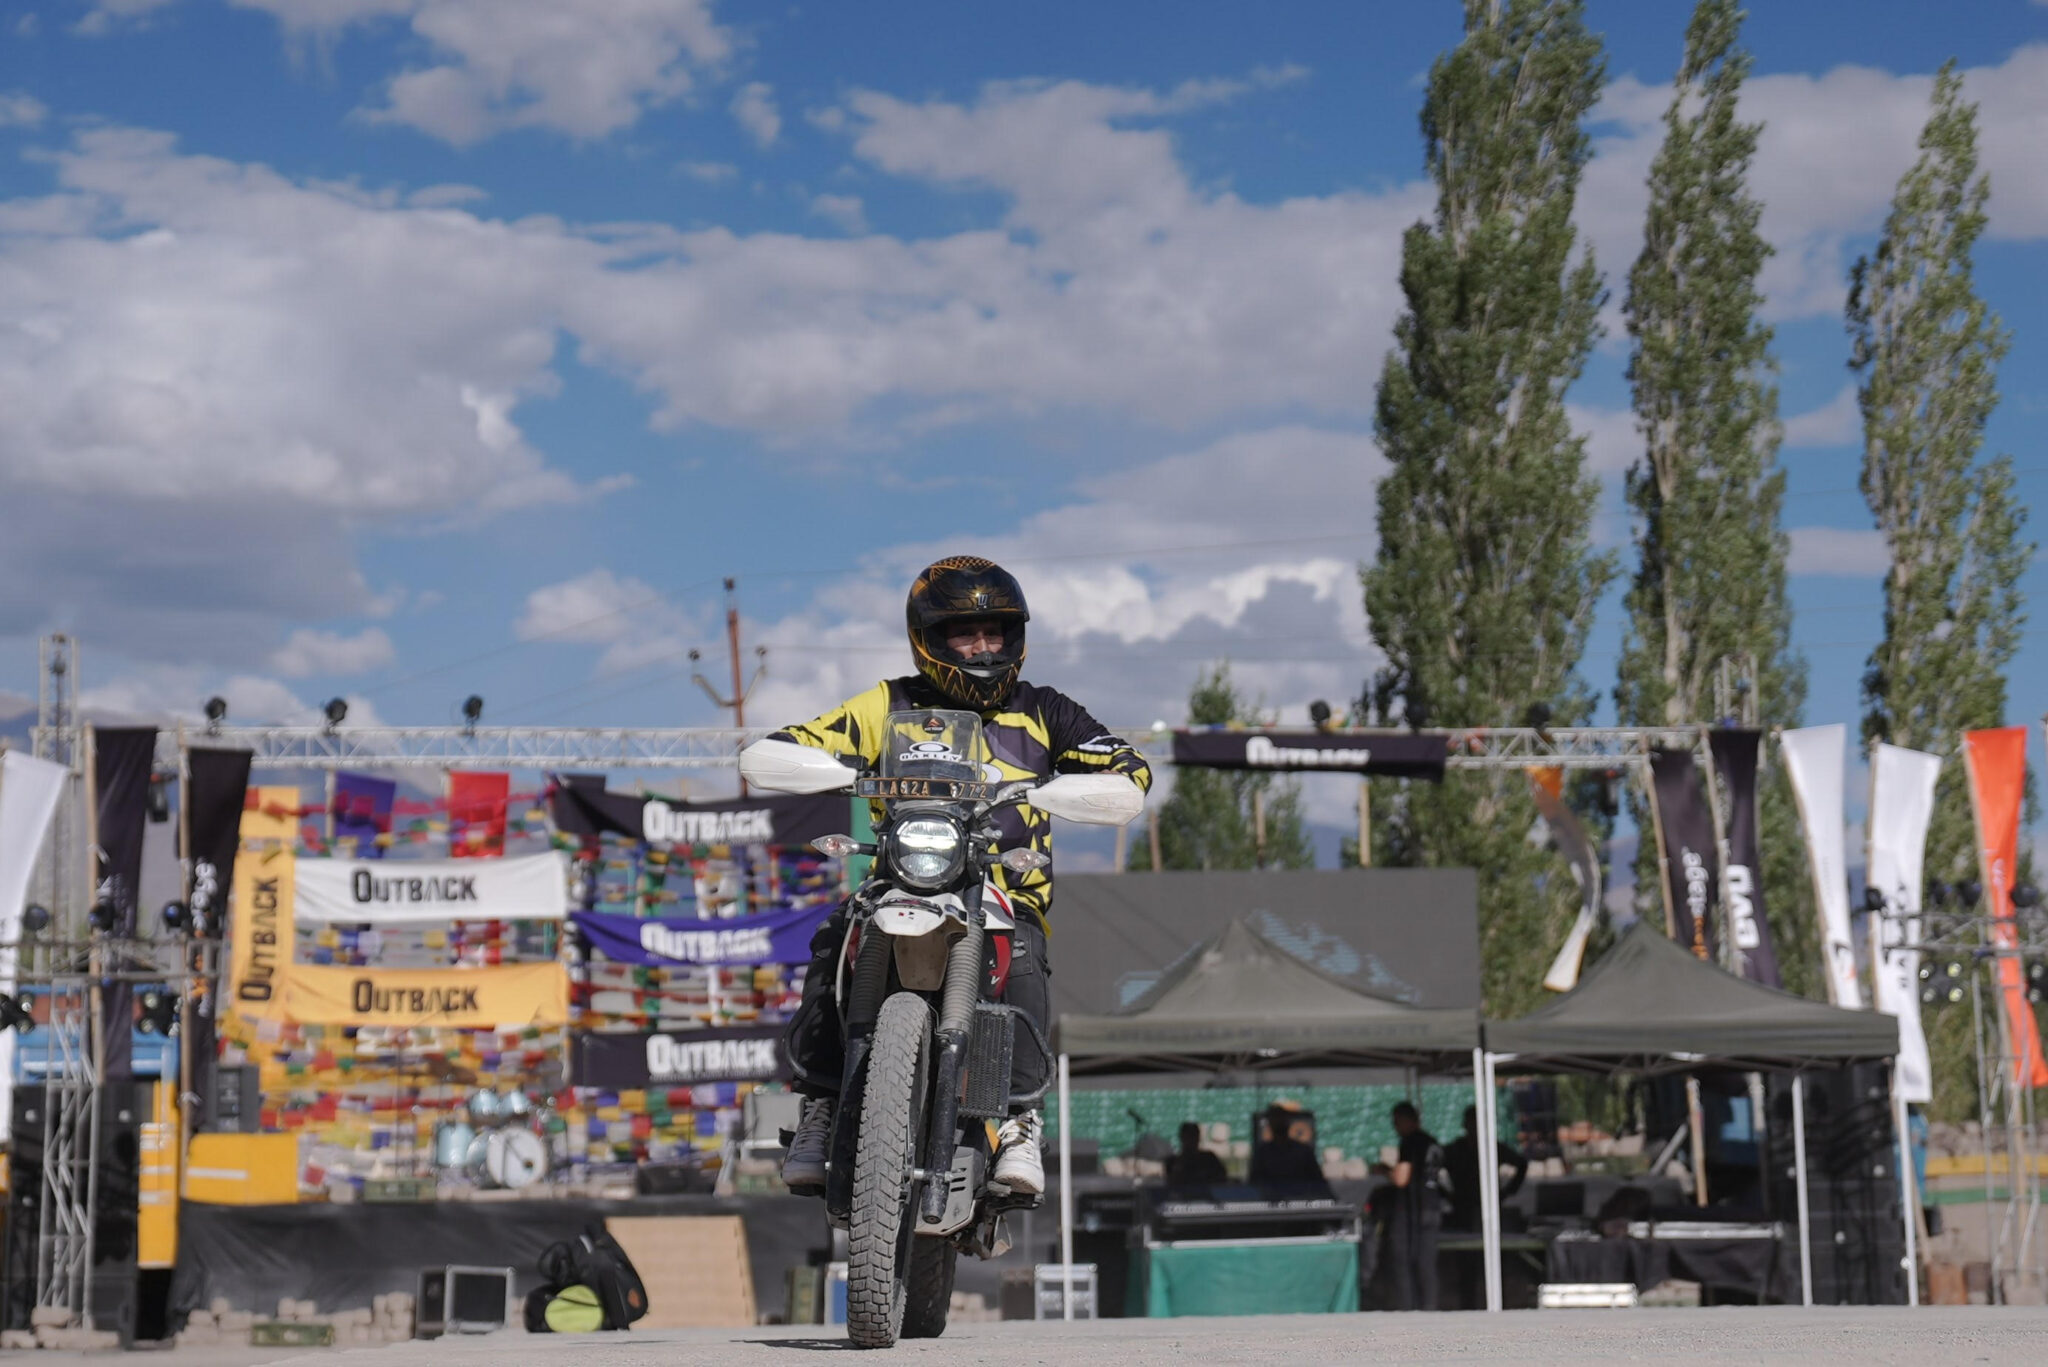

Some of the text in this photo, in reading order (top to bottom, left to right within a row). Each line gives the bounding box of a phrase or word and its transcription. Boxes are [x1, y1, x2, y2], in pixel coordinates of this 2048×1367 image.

[642, 800, 773, 842] OUTBACK
[351, 869, 479, 902] OUTBACK
[239, 876, 279, 1001] OUTBACK
[640, 922, 772, 962] OUTBACK
[352, 979, 480, 1013] OUTBACK
[646, 1034, 777, 1076] OUTBACK
